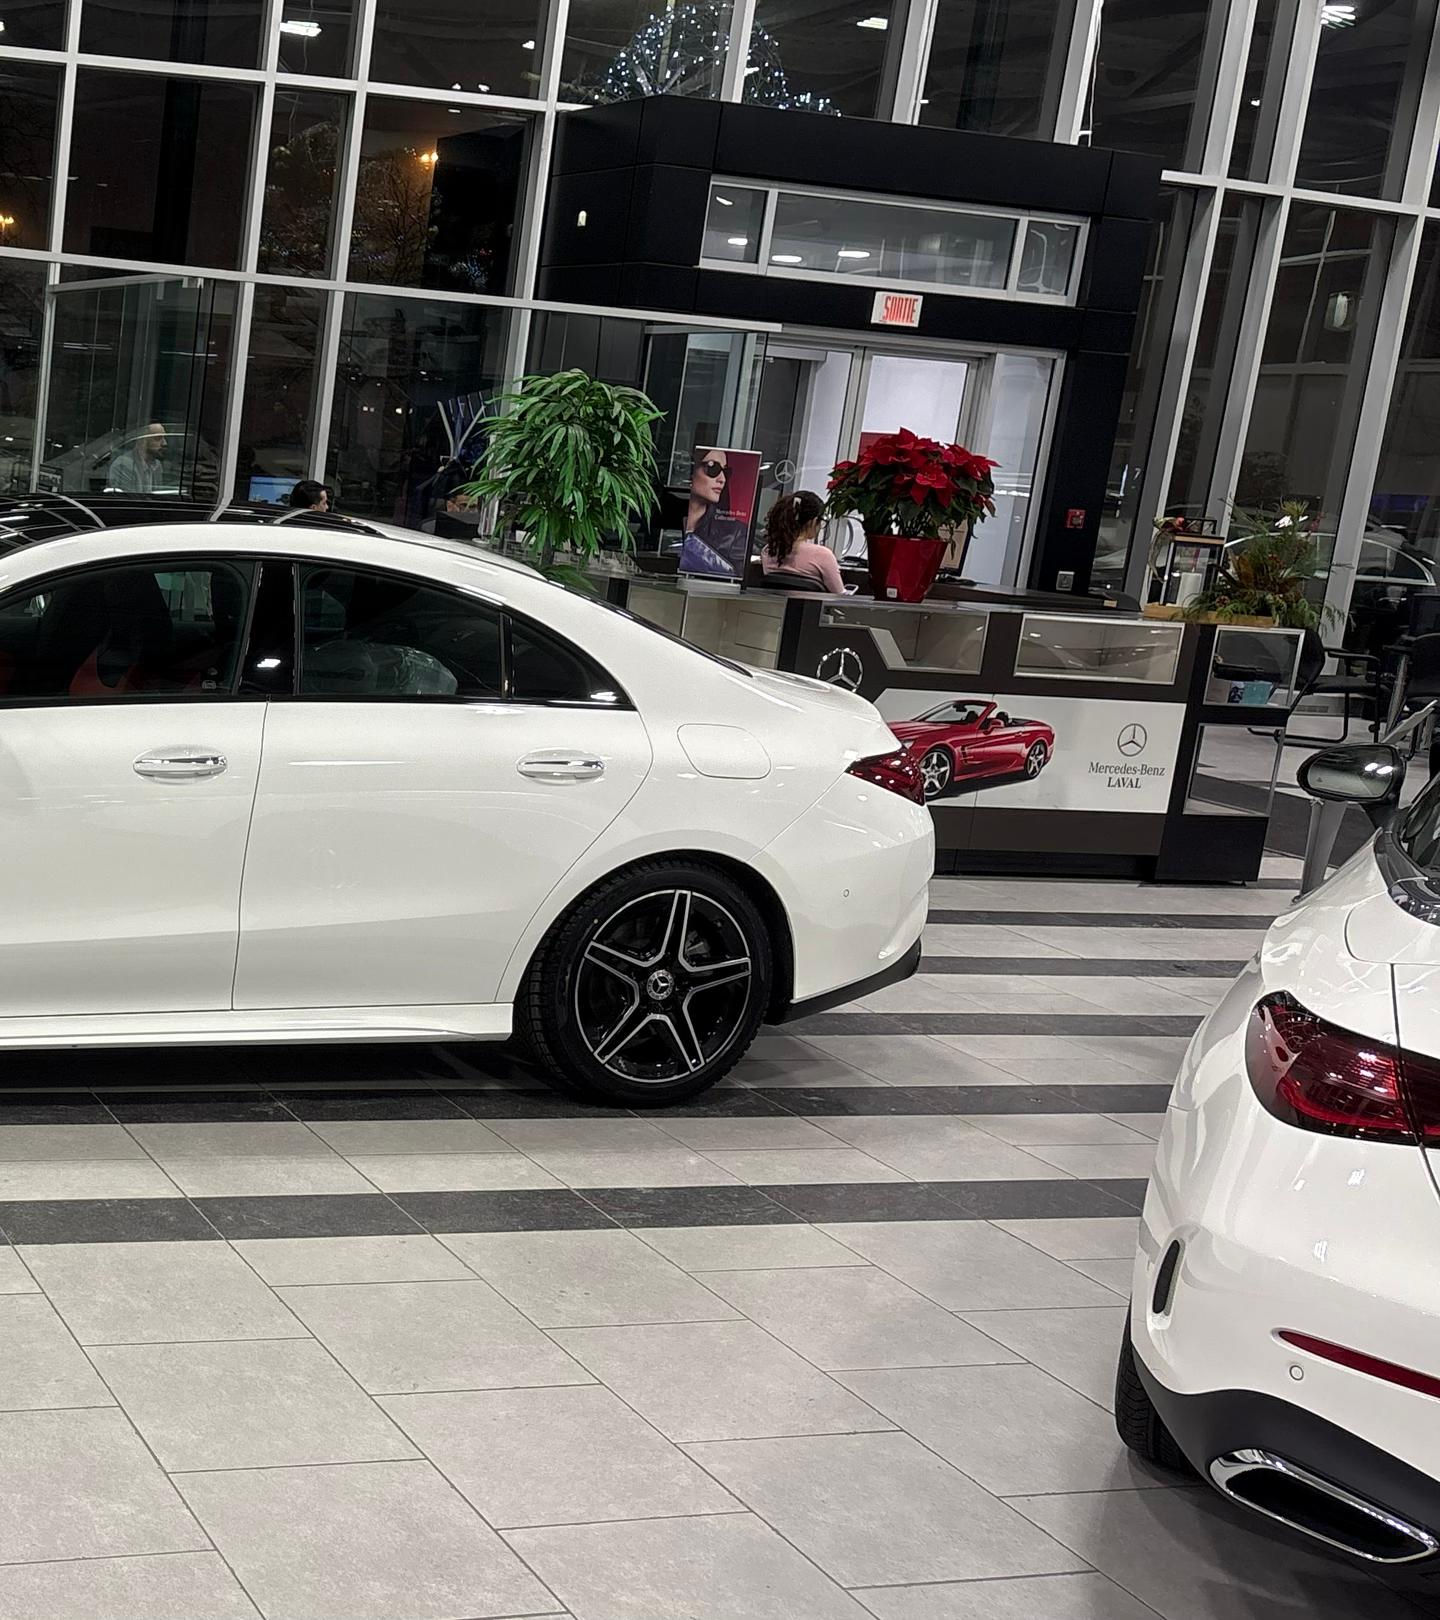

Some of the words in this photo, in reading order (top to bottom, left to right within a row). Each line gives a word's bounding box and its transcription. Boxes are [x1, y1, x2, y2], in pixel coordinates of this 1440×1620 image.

[882, 296, 919, 324] SORTIE
[1088, 761, 1166, 776] Mercedes-Benz
[1106, 776, 1142, 789] LAVAL
